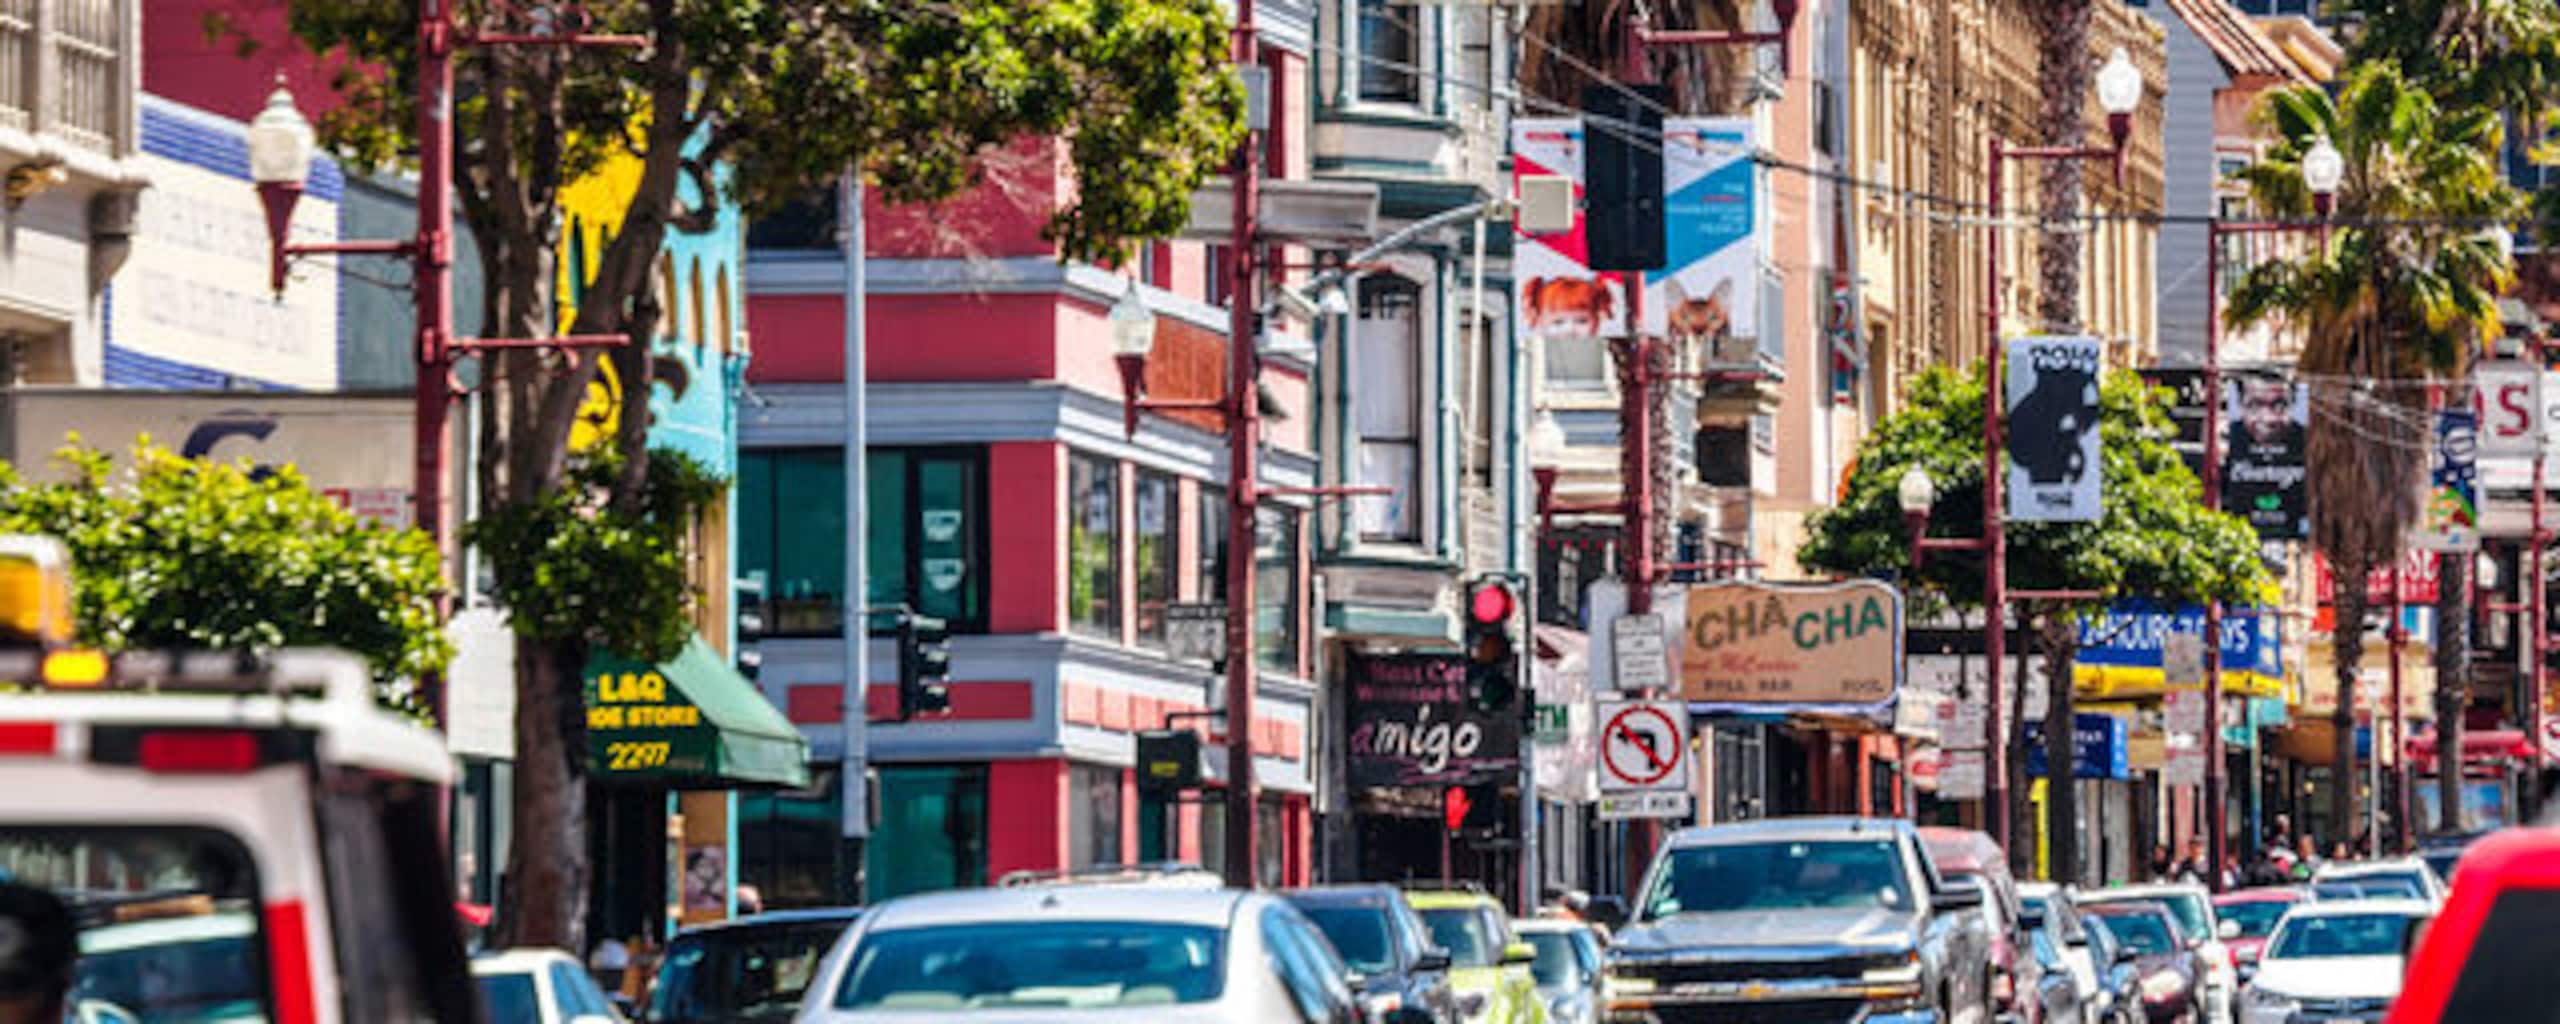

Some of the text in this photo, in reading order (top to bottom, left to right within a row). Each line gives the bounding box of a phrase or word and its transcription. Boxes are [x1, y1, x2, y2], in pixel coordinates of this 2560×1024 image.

[1694, 594, 1789, 650] CHA
[1792, 594, 1887, 650] CHA
[627, 704, 699, 728] STORE
[606, 741, 671, 770] 2297
[1351, 702, 1483, 774] amigo
